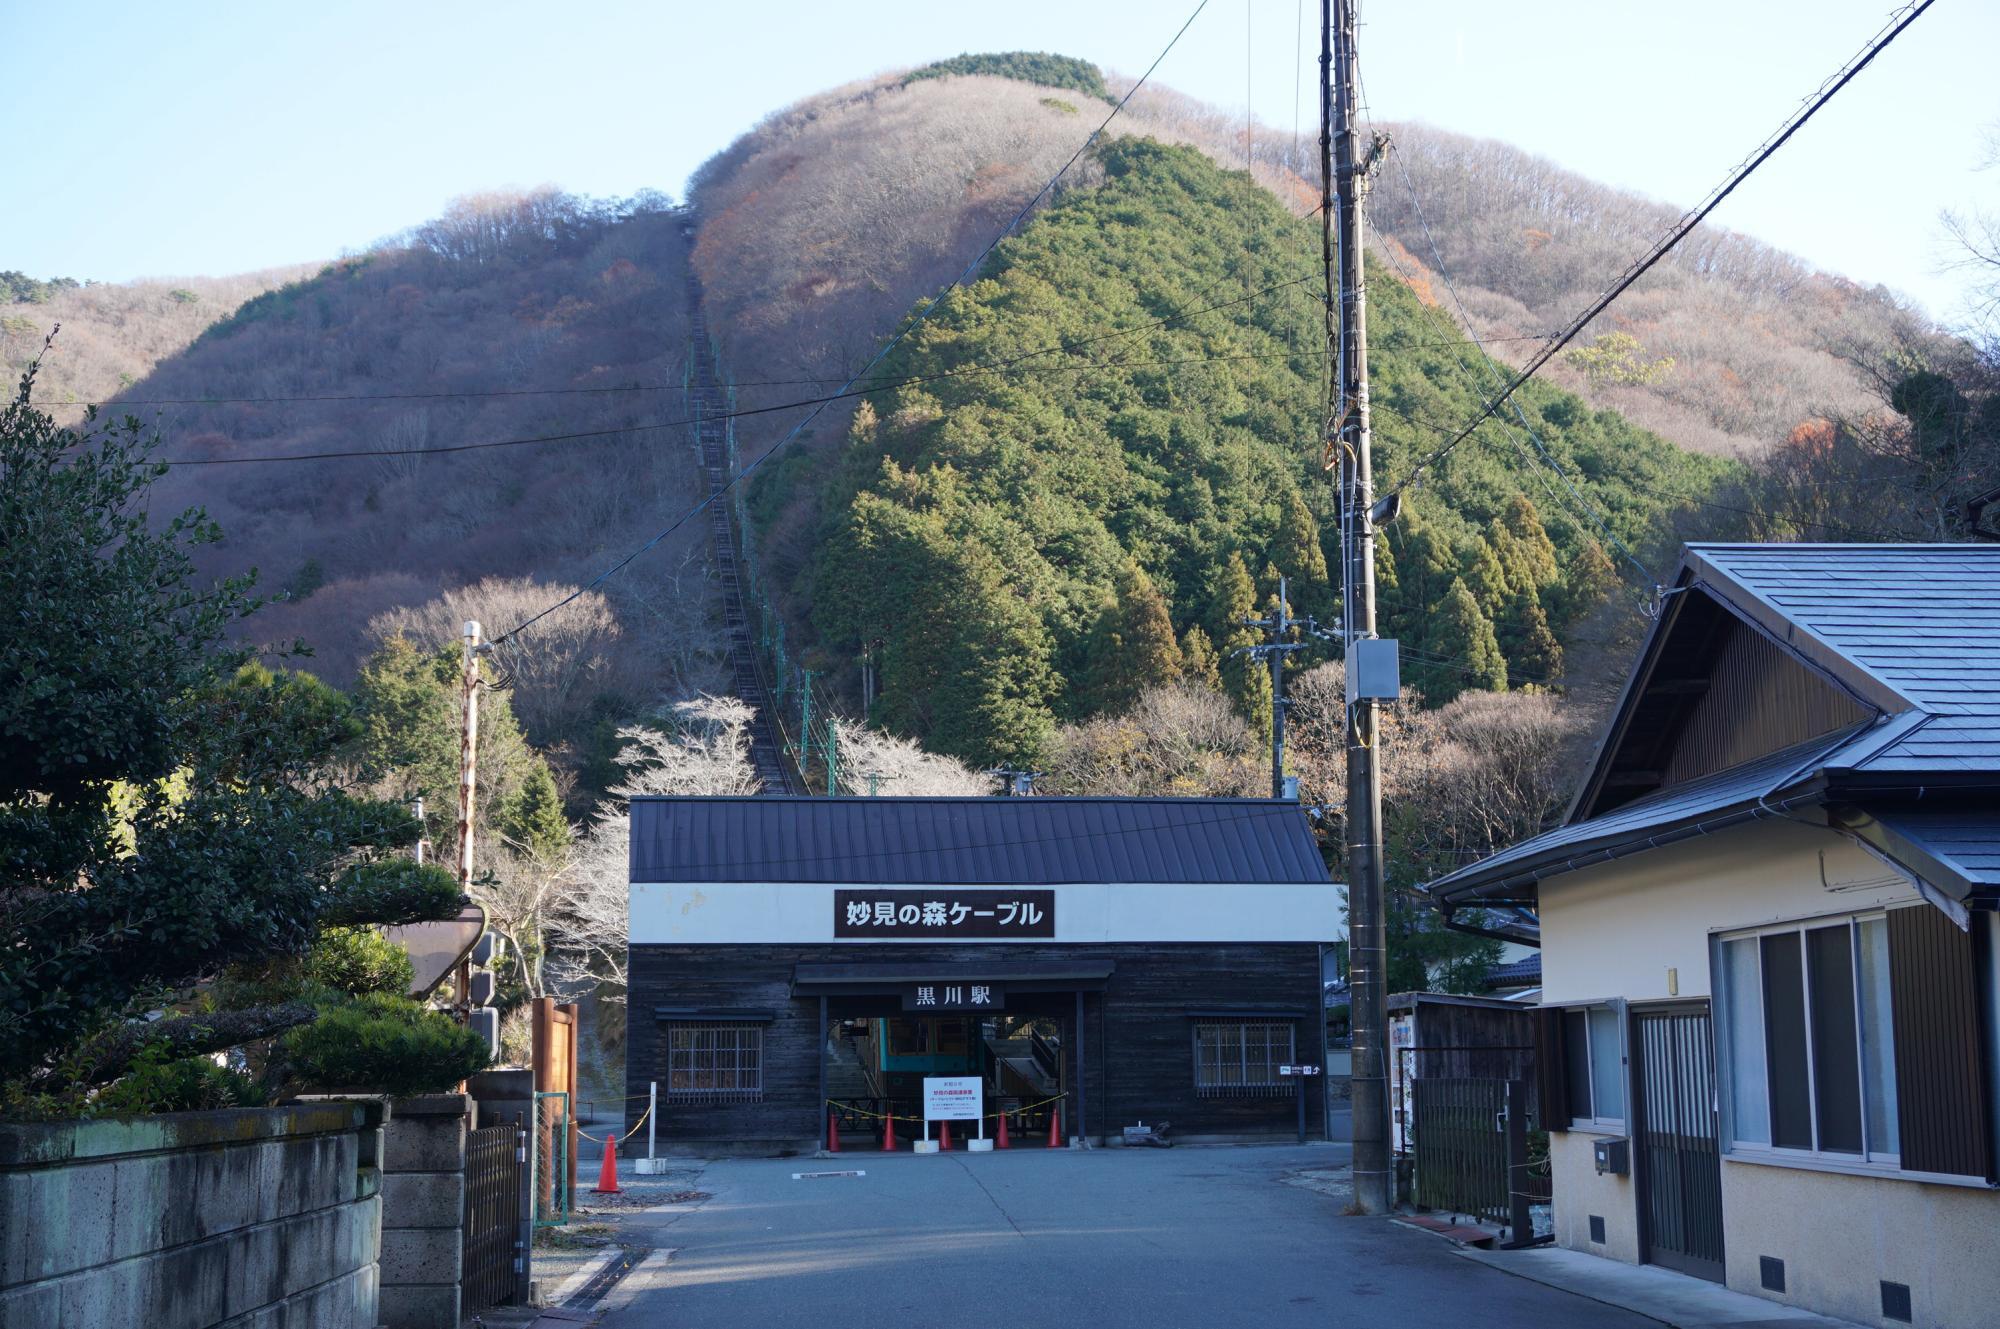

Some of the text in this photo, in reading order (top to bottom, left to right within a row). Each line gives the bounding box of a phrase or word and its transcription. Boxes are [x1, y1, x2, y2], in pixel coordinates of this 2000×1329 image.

[846, 901, 1044, 926] 妙見の森ケーブル
[916, 985, 991, 1006] 黒川駅
